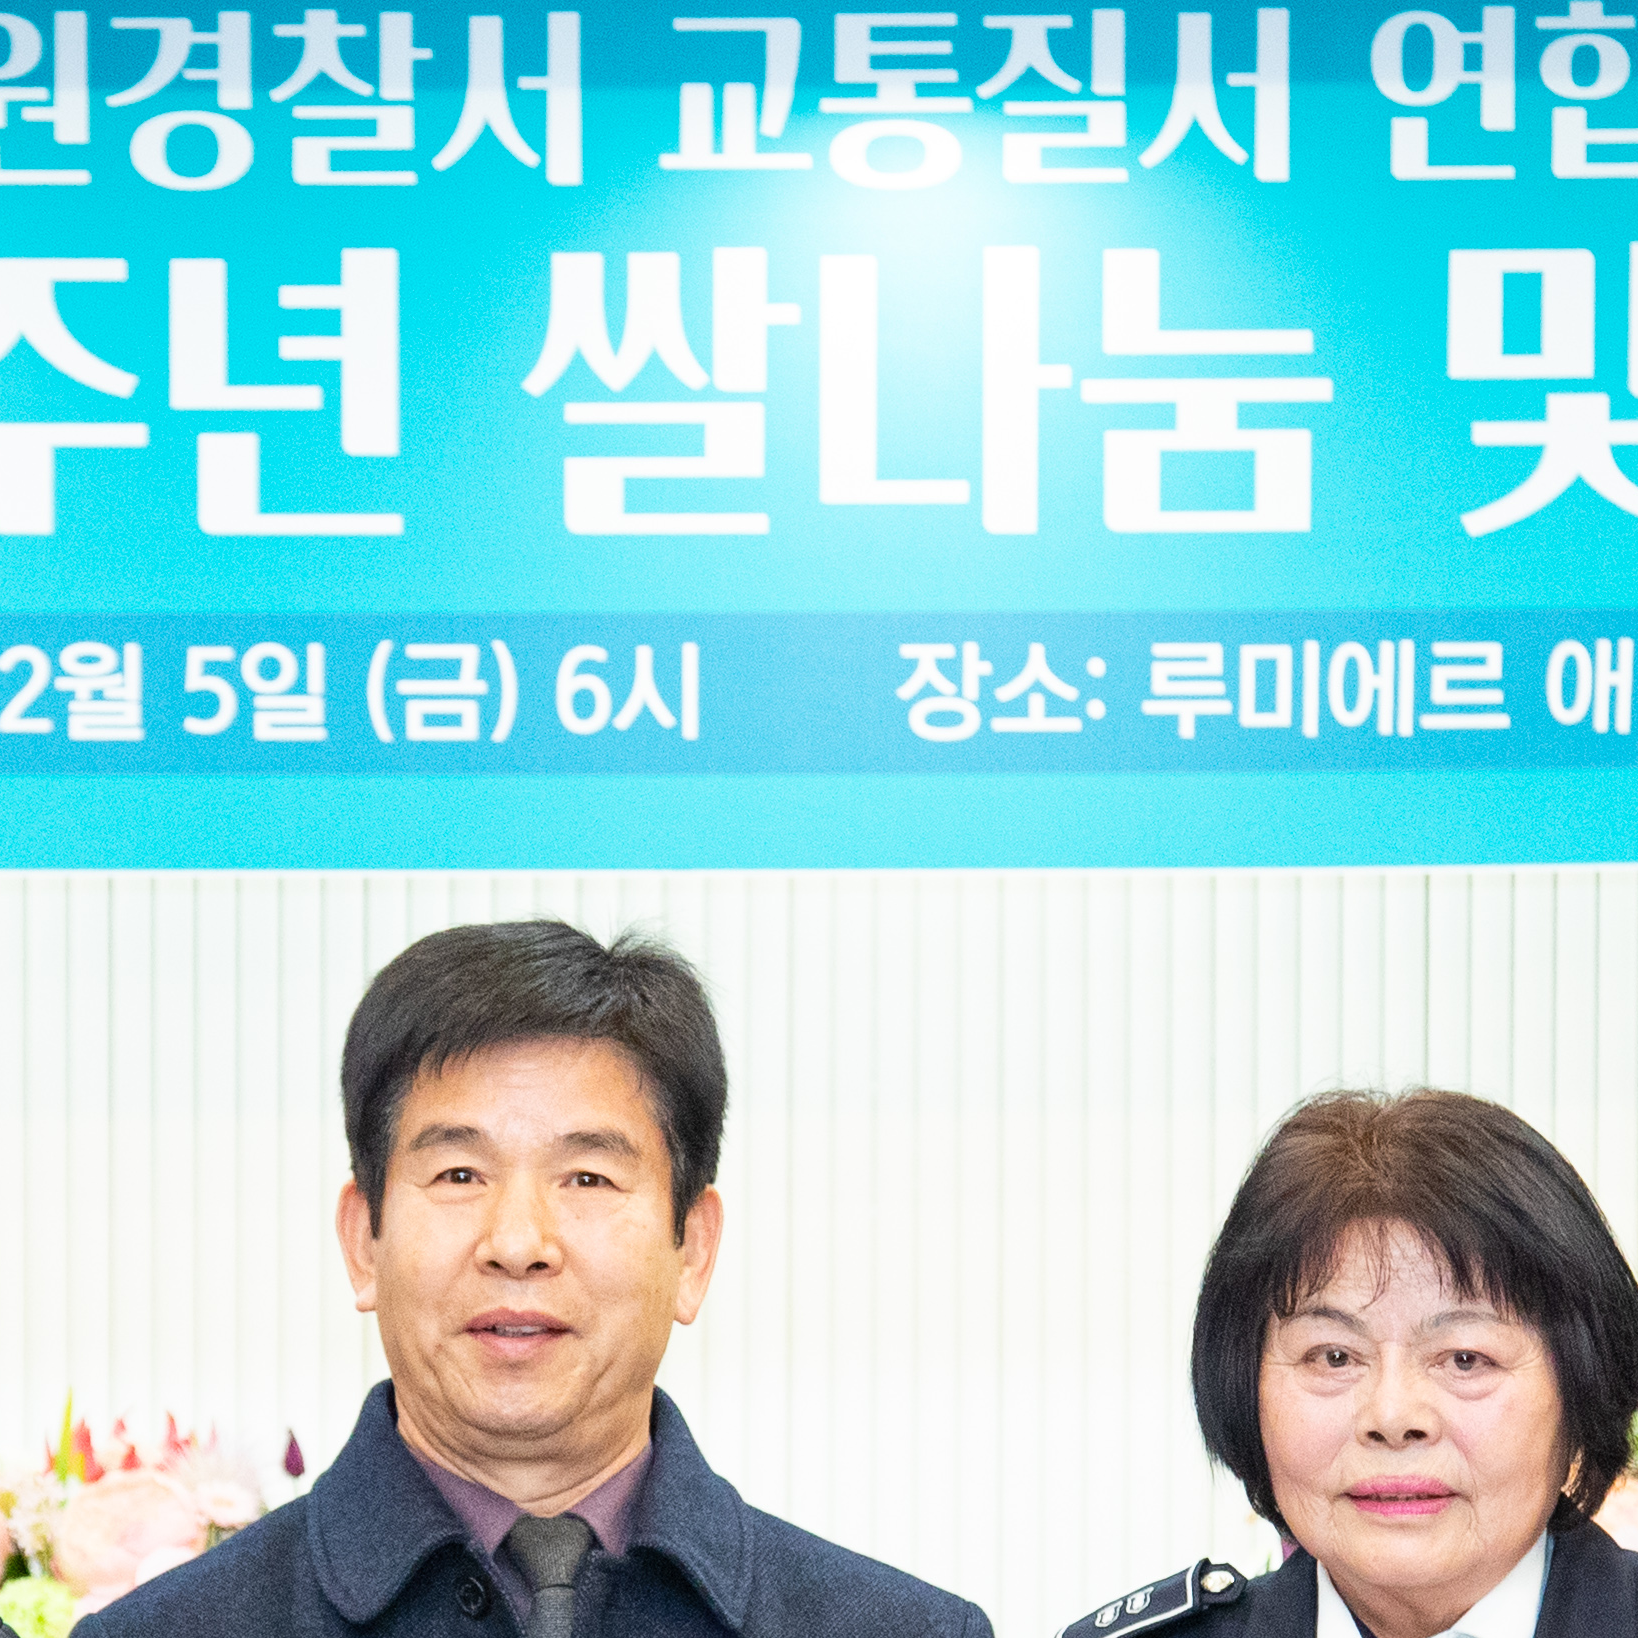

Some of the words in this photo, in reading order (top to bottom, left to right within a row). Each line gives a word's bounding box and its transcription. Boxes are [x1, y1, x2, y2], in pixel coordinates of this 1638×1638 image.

[659, 12, 1289, 191] 교통질서
[524, 246, 1333, 536] 쌀나눔
[183, 641, 328, 742] 5일
[366, 639, 519, 744] (금)
[555, 640, 701, 742] 6시
[894, 639, 1108, 744] 장소:
[1140, 638, 1511, 741] 루미에르
